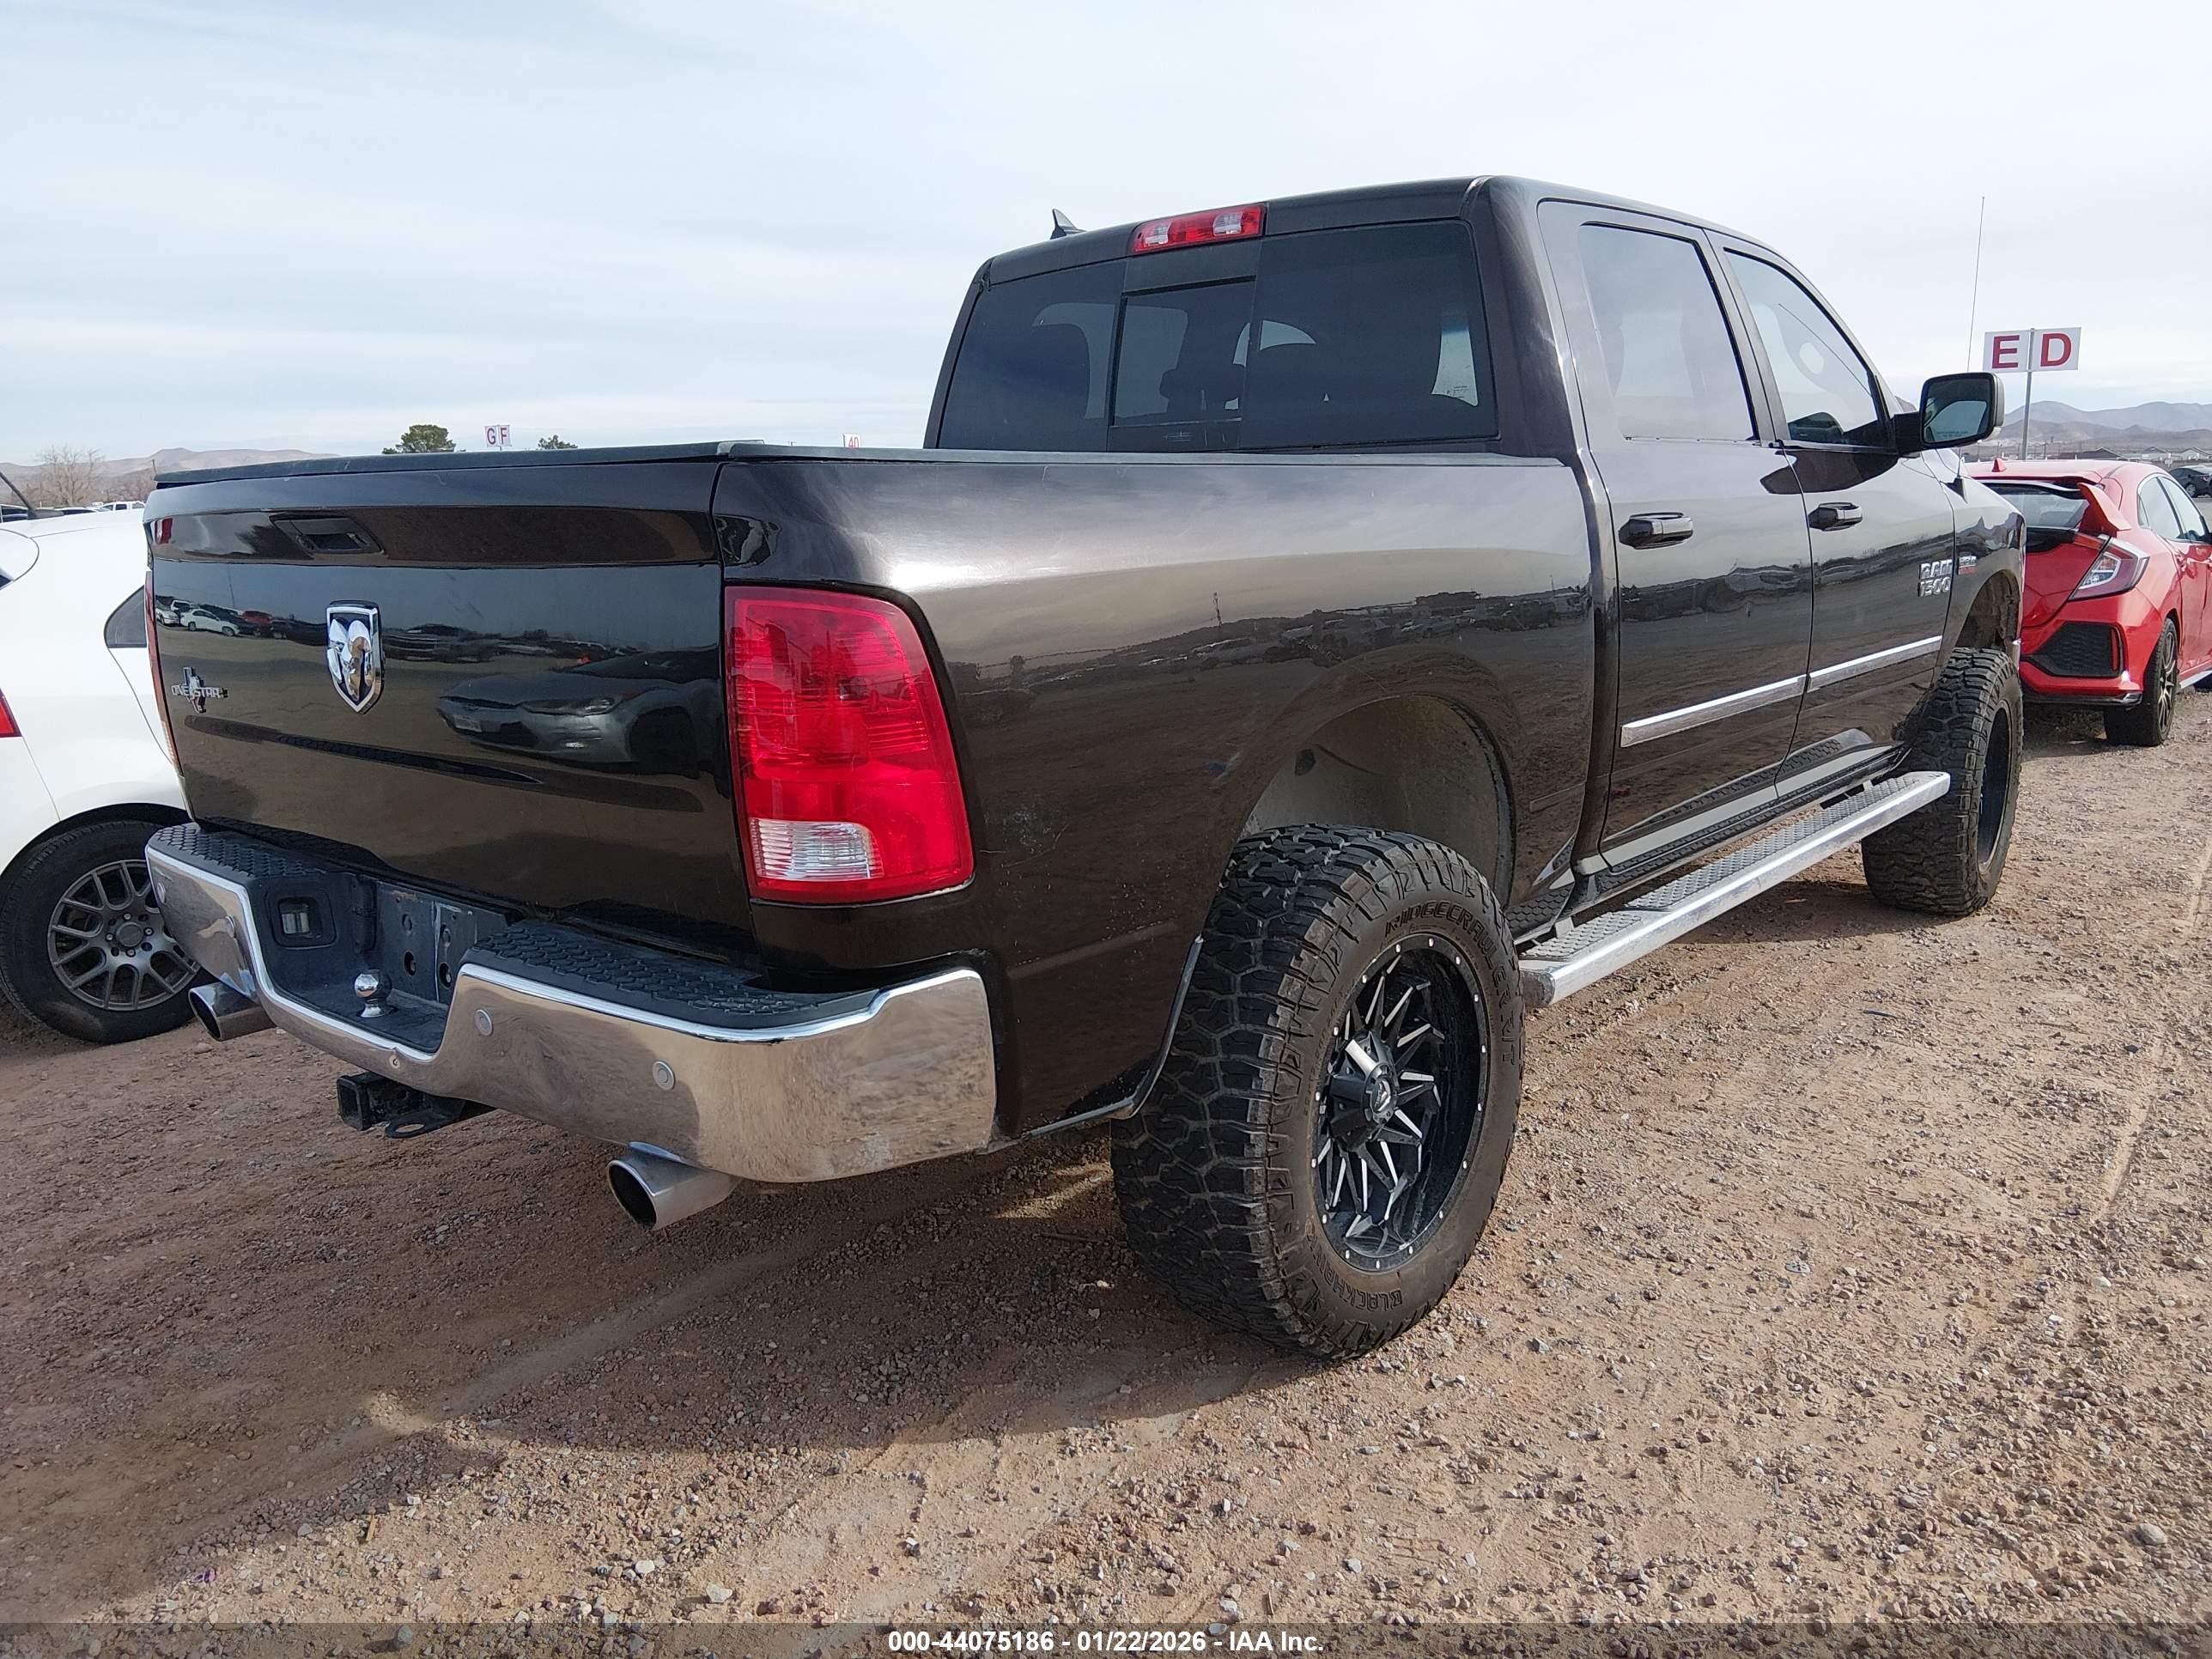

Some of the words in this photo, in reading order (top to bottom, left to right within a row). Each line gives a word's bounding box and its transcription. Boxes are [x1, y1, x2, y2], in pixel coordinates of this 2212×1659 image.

[1992, 335, 2020, 368] E
[2040, 333, 2071, 367] D
[487, 428, 496, 445] G
[500, 427, 507, 445] F
[1919, 559, 1953, 580] RAM
